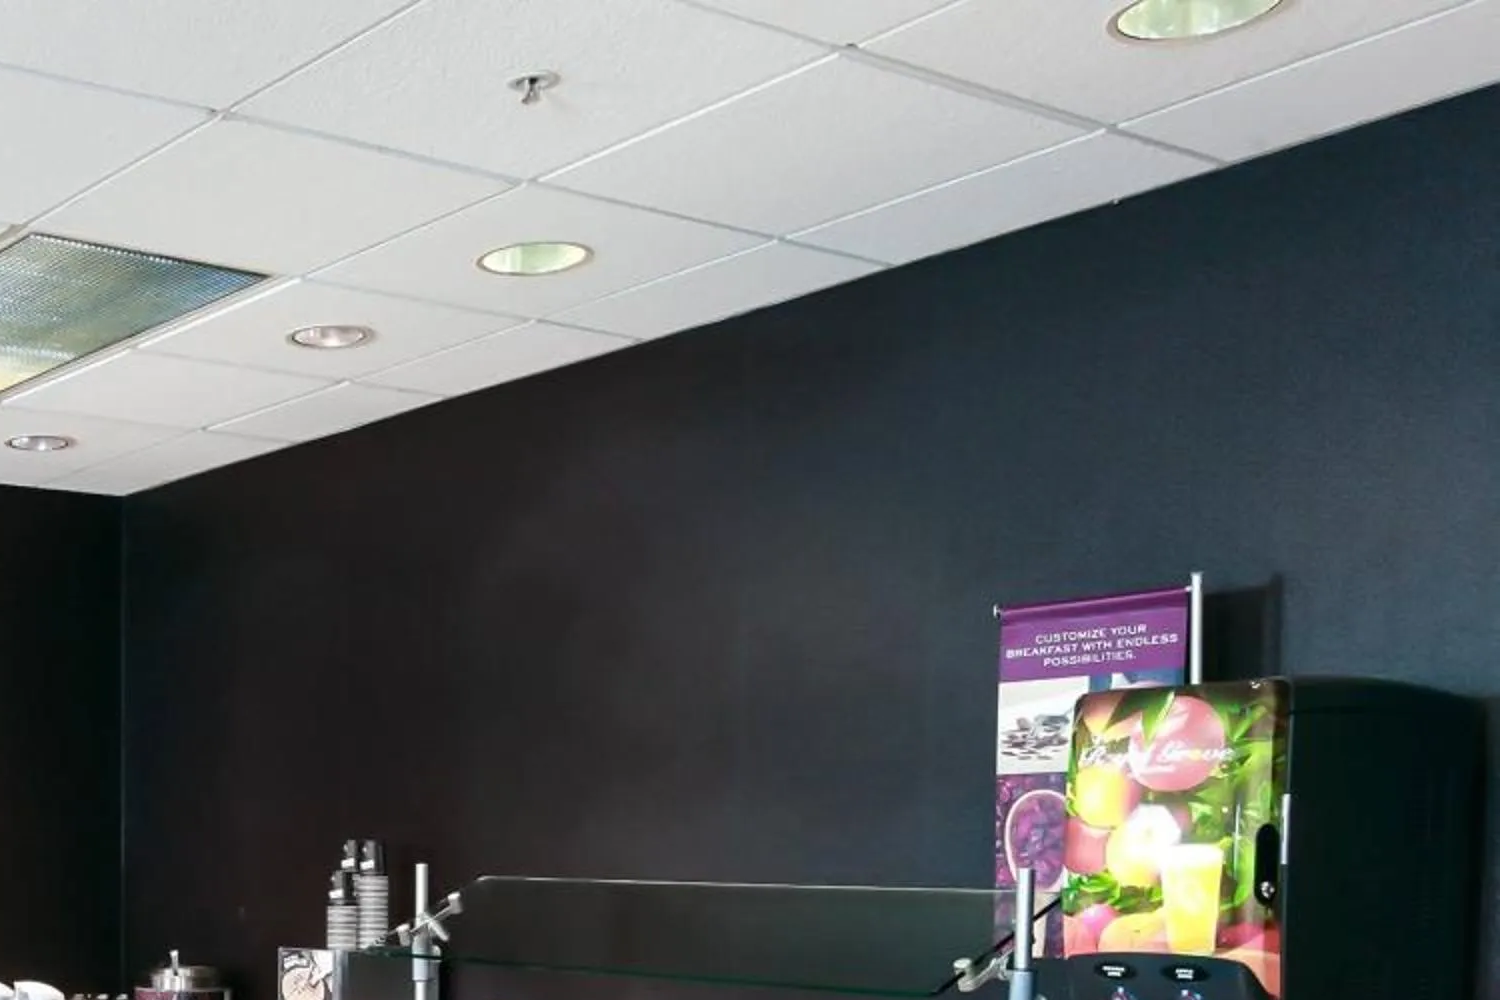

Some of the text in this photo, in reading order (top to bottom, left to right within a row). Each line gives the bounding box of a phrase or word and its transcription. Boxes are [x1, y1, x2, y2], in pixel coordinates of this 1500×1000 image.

[1005, 632, 1179, 660] BREAKFAST WITH ENDLESS
[1035, 623, 1148, 645] CUSTOMIZE YOUR
